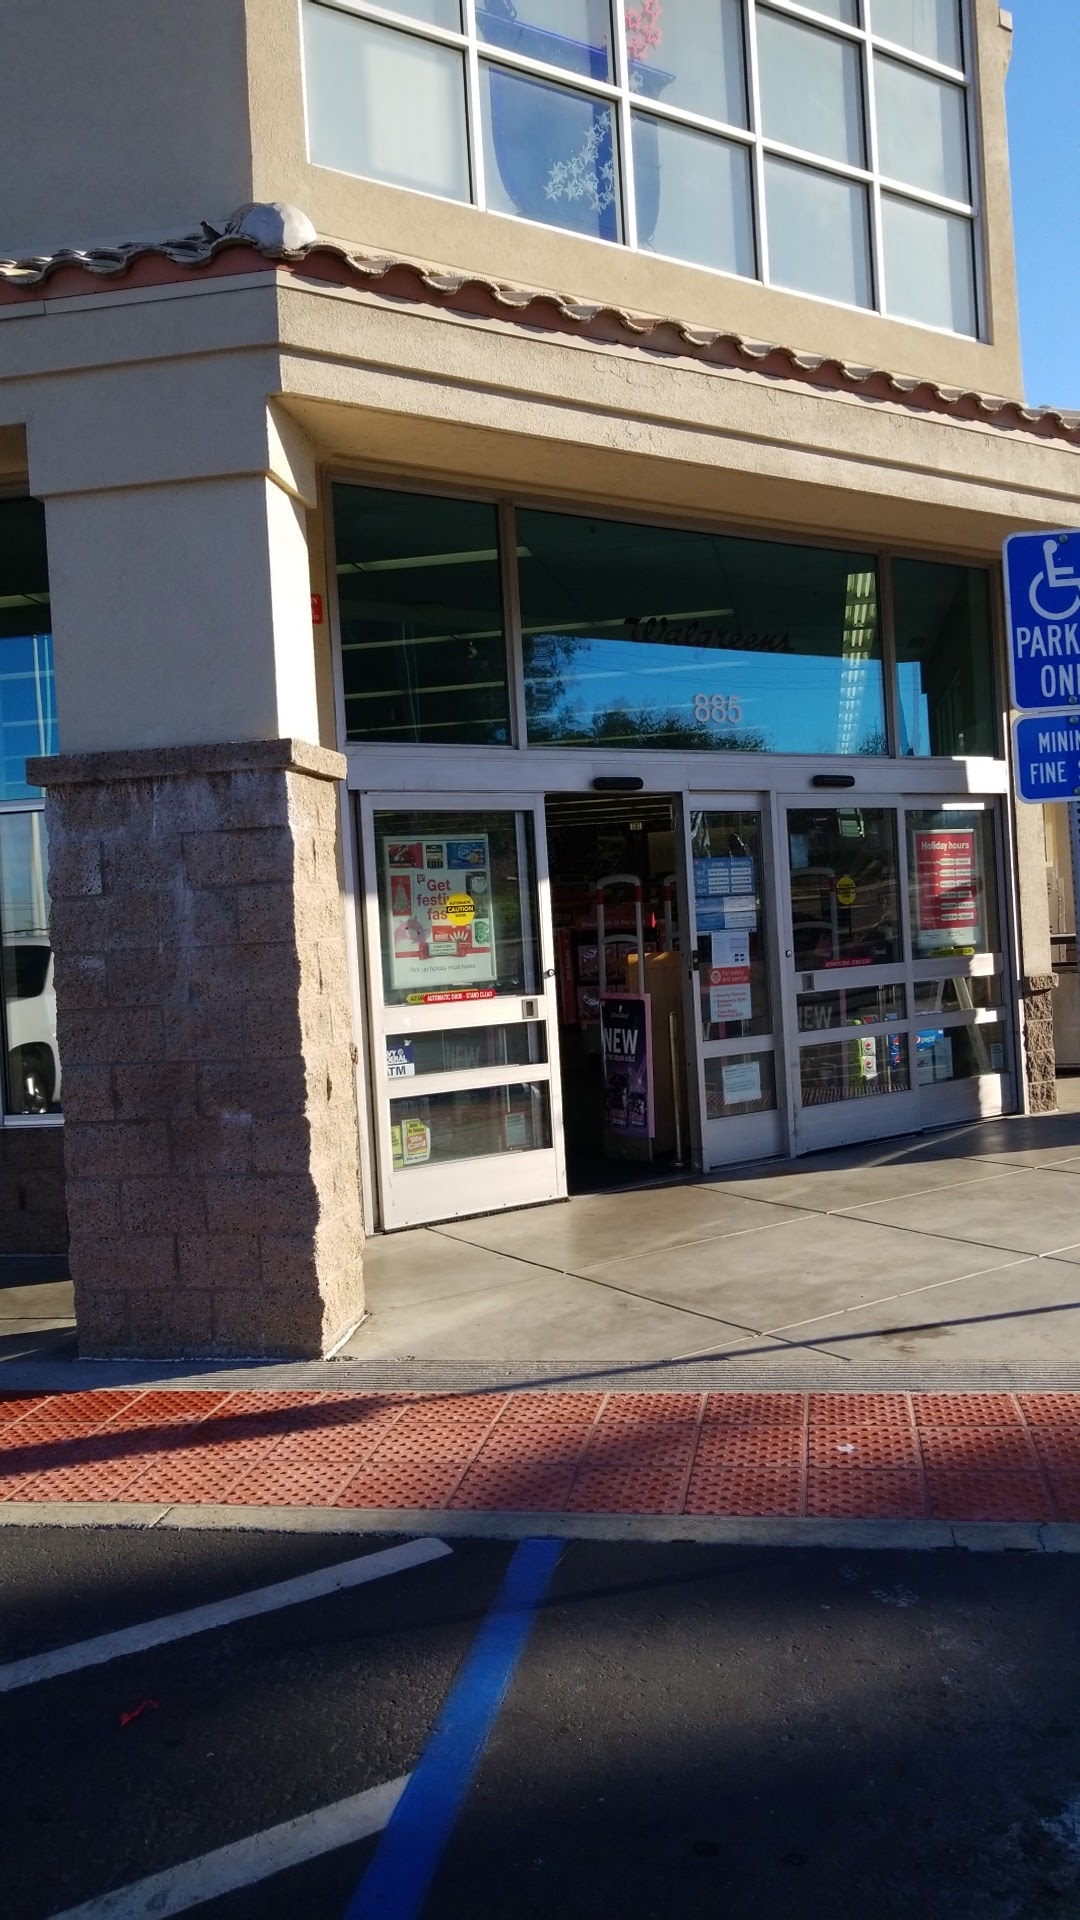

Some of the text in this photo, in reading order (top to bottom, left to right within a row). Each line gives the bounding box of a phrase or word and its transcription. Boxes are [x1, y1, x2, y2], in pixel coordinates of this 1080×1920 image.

[623, 617, 796, 656] Walgreens
[694, 693, 743, 724] 885
[1030, 761, 1067, 784] FINE
[921, 841, 970, 851] Holiday hours
[427, 878, 451, 892] Get
[429, 964, 447, 972] holiday
[426, 993, 451, 1002] AUTOMATIC
[451, 992, 462, 1000] DOOR
[465, 991, 480, 999] STAND
[480, 990, 493, 998] CLEAR
[604, 1027, 639, 1054] NEW
[408, 1140, 426, 1150] Card
[410, 1135, 423, 1143] We
